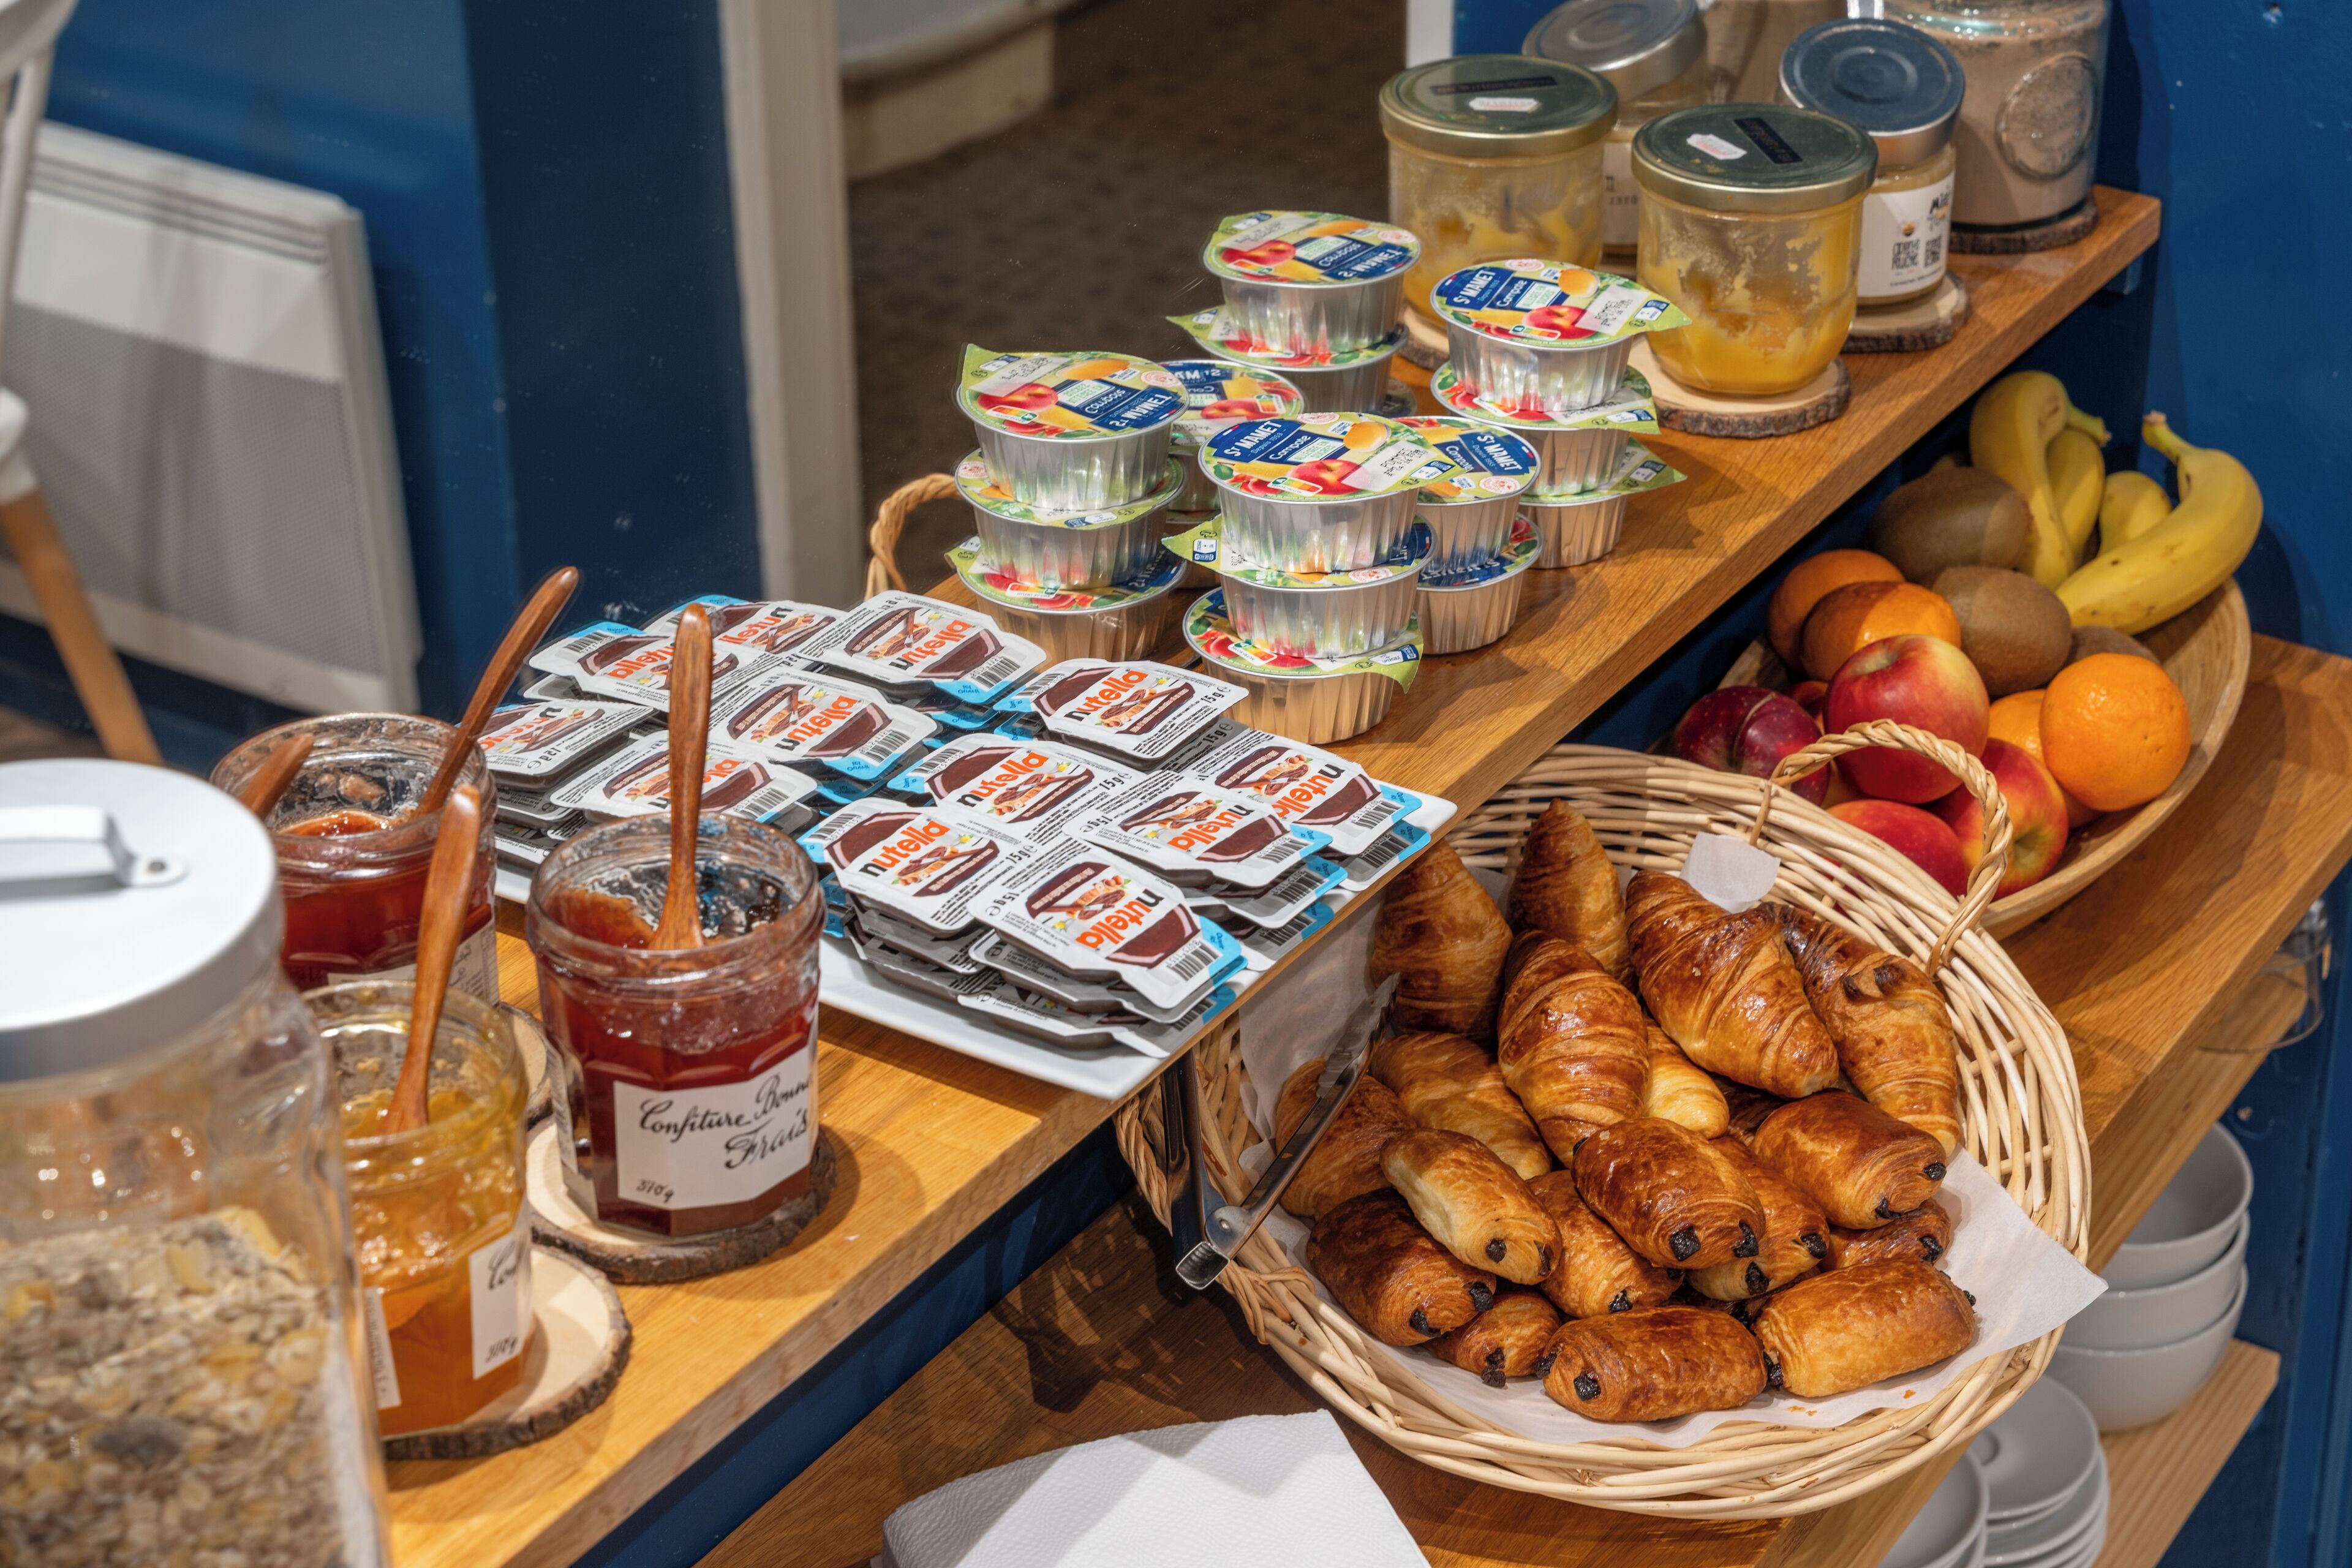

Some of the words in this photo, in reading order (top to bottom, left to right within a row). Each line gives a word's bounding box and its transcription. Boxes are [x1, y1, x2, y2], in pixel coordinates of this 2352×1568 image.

[1466, 270, 1496, 298] MAMET
[1496, 280, 1528, 307] Compote
[1240, 421, 1282, 451] MAMET
[1269, 435, 1311, 460] Compote
[1484, 443, 1523, 470] MAMET
[1063, 670, 1149, 722] nutella
[957, 750, 1050, 807] nutella
[1272, 763, 1347, 819] nutella
[859, 820, 951, 877] nutella
[1167, 805, 1254, 852] nutella
[1076, 888, 1164, 950] nutella
[639, 1098, 751, 1144] Confiture
